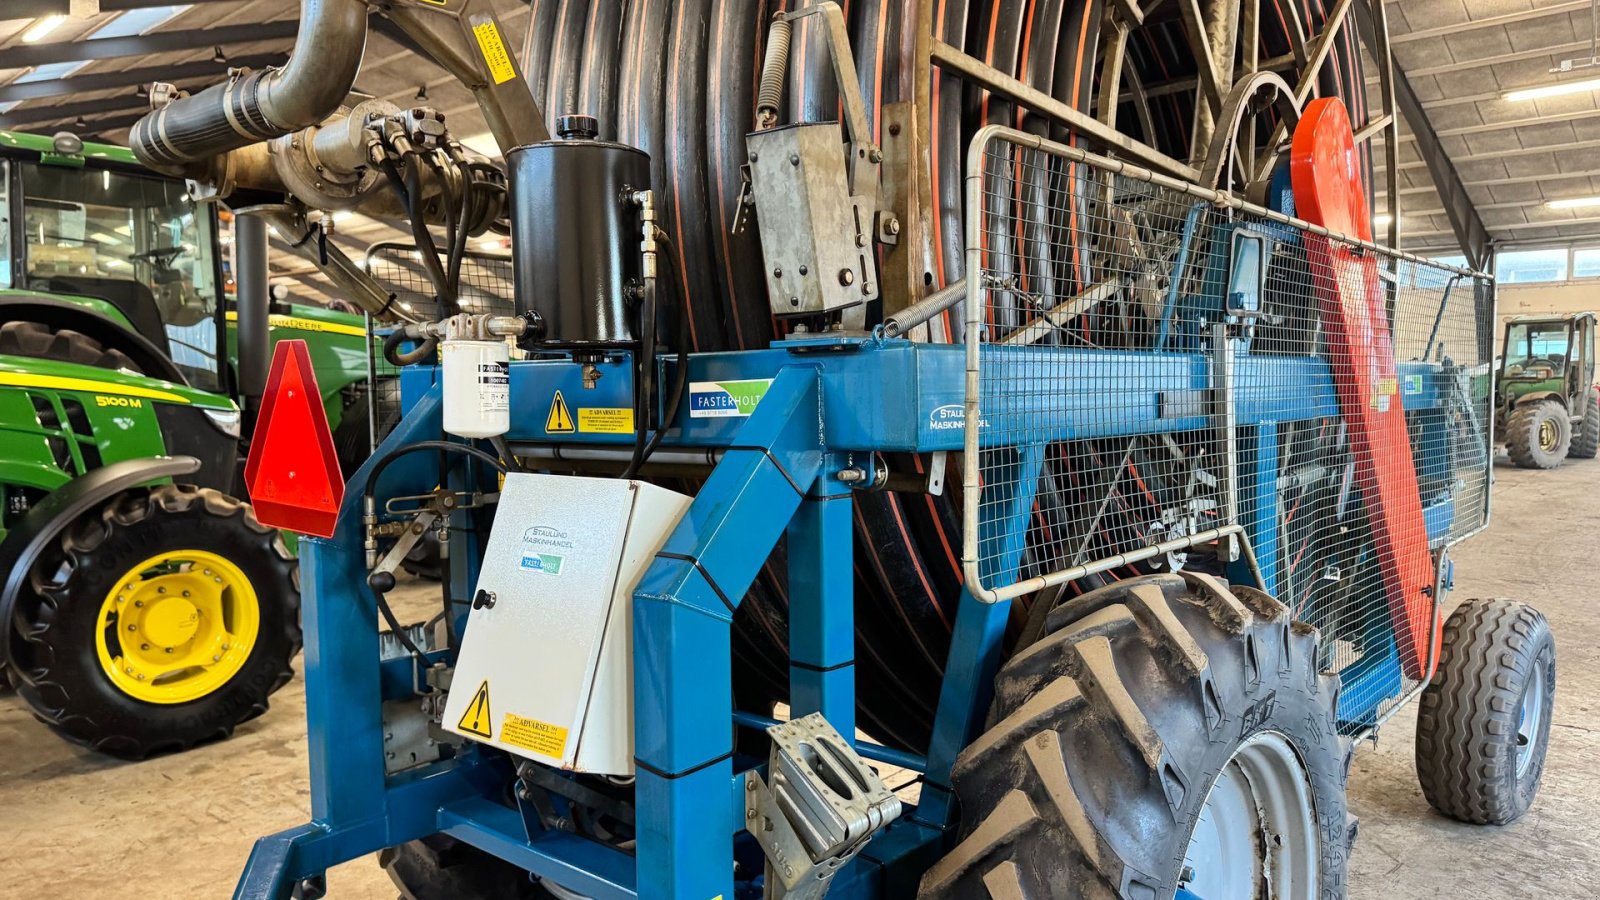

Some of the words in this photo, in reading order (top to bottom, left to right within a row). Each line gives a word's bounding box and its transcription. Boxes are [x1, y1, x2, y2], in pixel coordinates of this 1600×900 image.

[290, 319, 322, 329] DEERE
[698, 394, 761, 407] FASTERHOLT
[532, 528, 568, 539] STAULUND
[522, 536, 574, 549] MASKINHANDEL
[519, 719, 550, 733] ADVARSEL
